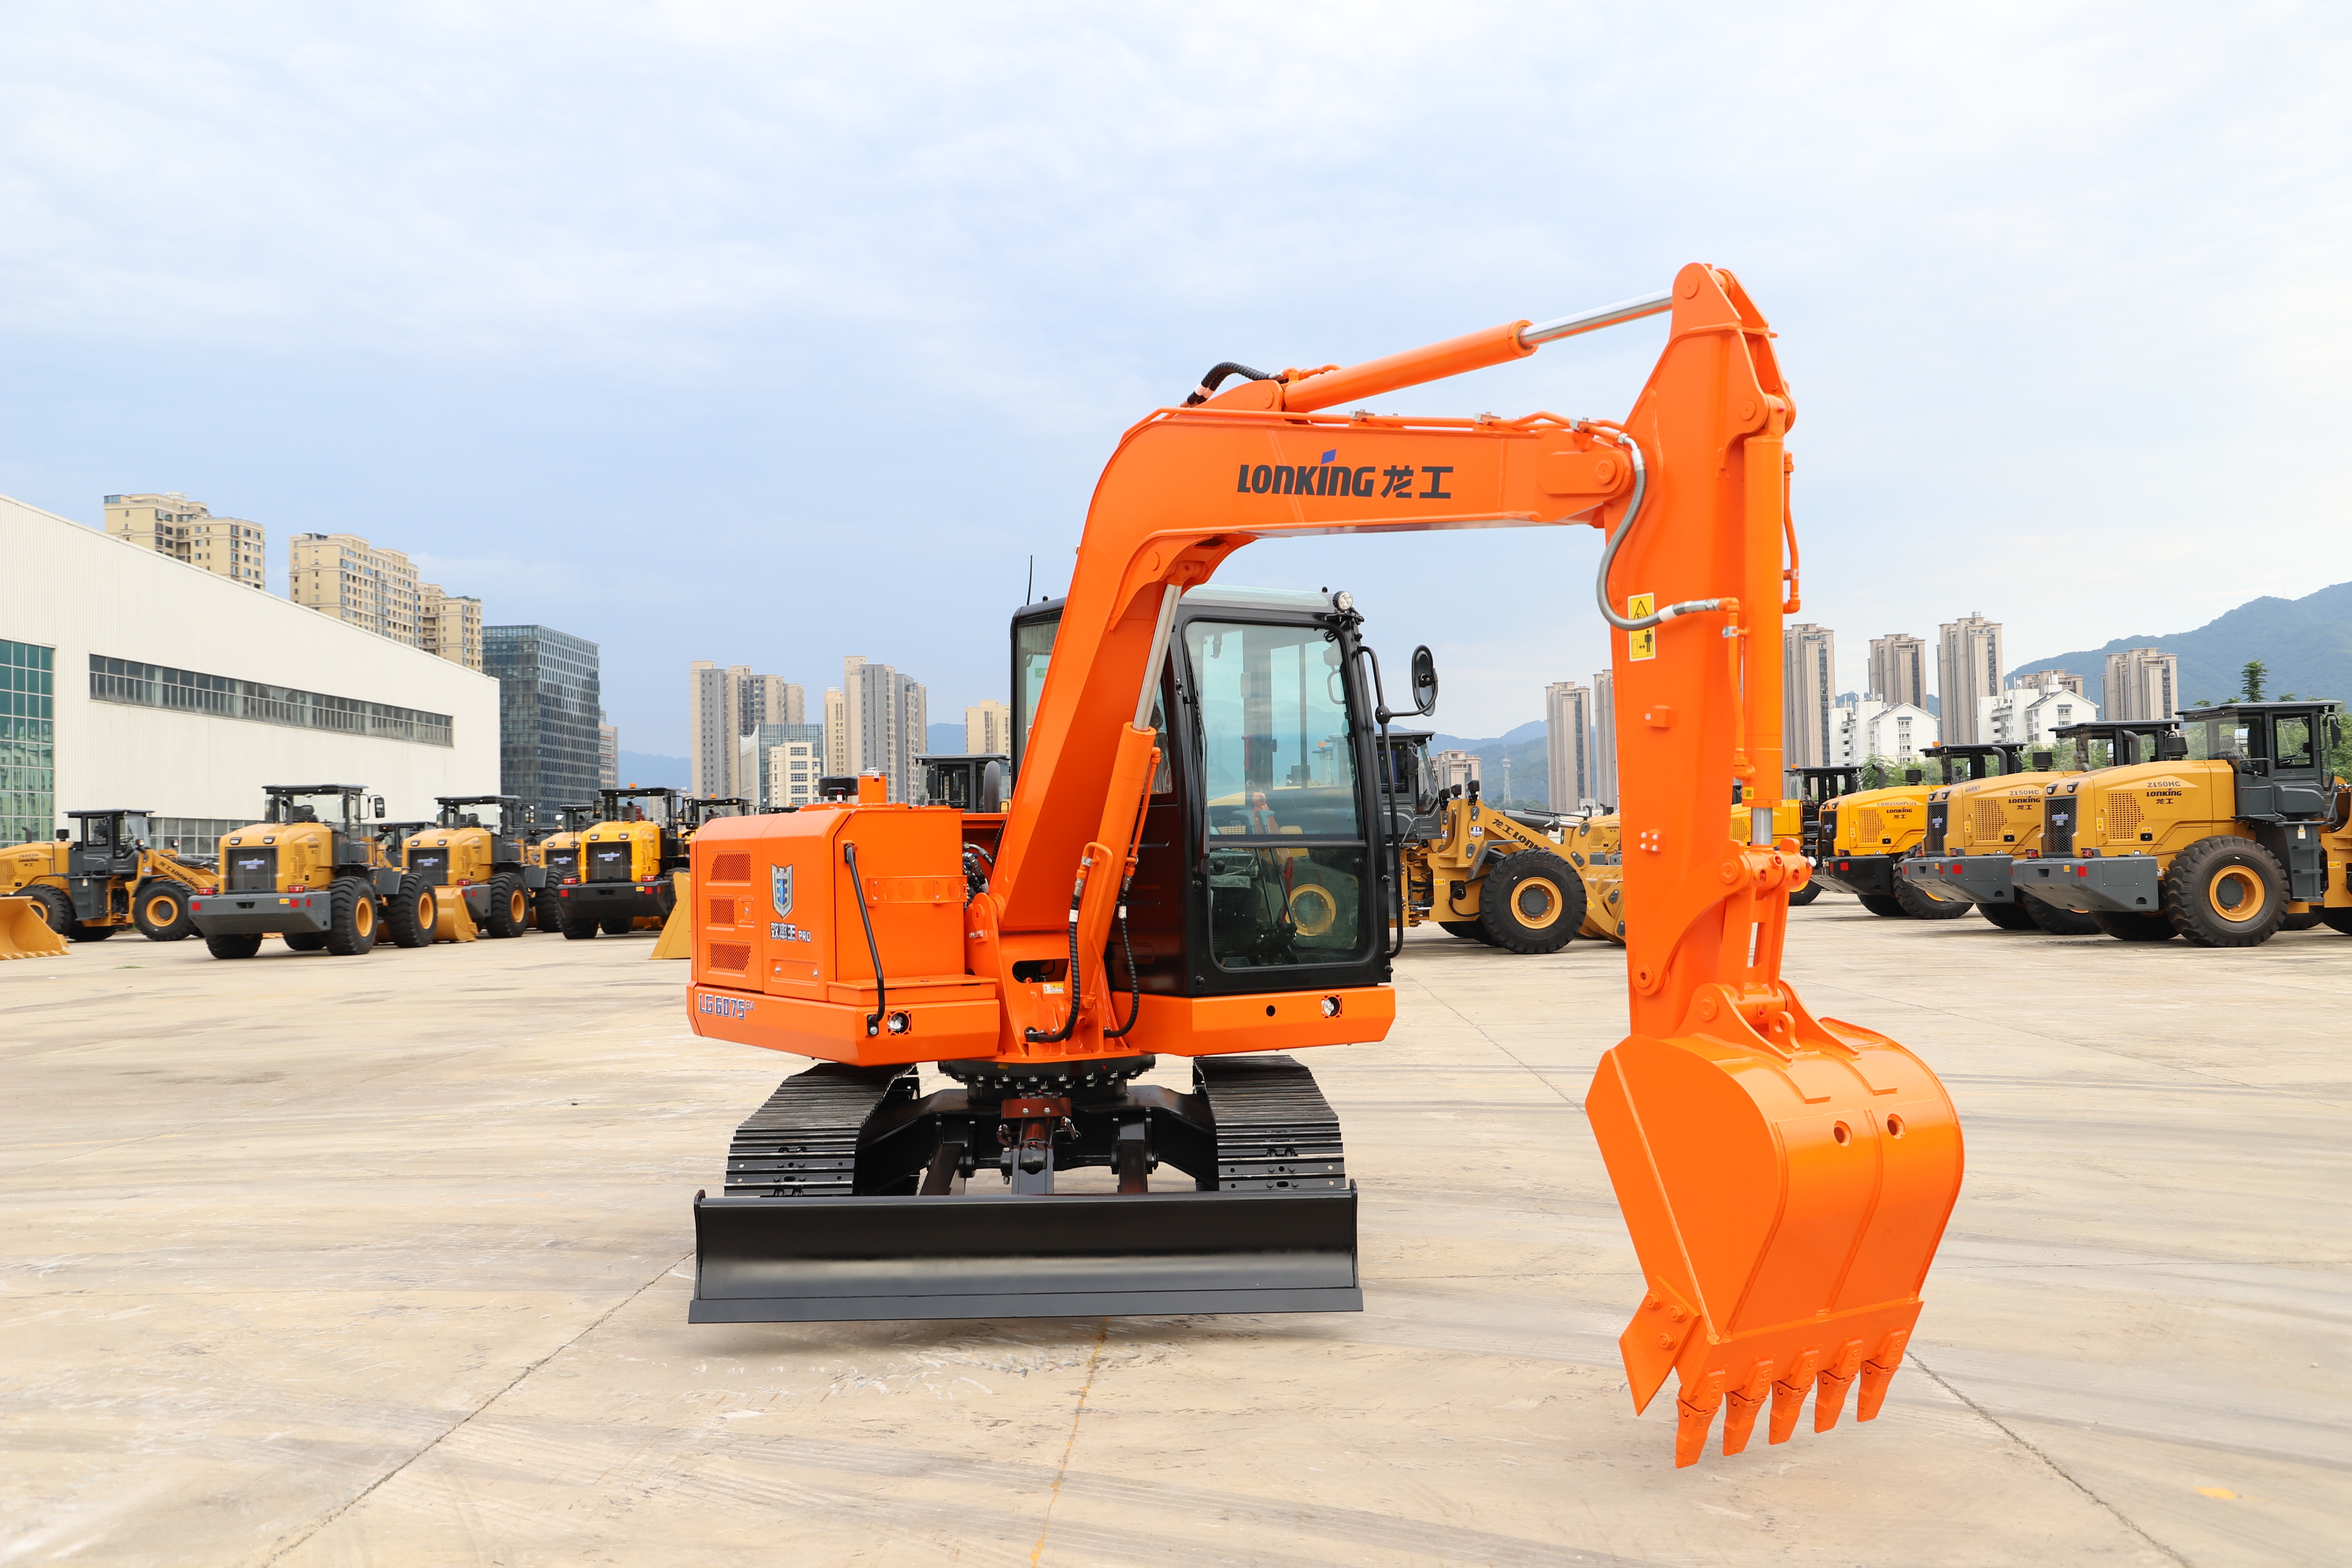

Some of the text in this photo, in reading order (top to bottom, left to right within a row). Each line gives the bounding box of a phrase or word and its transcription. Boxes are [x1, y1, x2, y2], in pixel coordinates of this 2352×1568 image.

[1237, 449, 1454, 499] LONKING 龙工
[2146, 788, 2182, 797] LONKING
[1492, 818, 1514, 835] 龙工
[770, 921, 812, 943] 效率王 PRO
